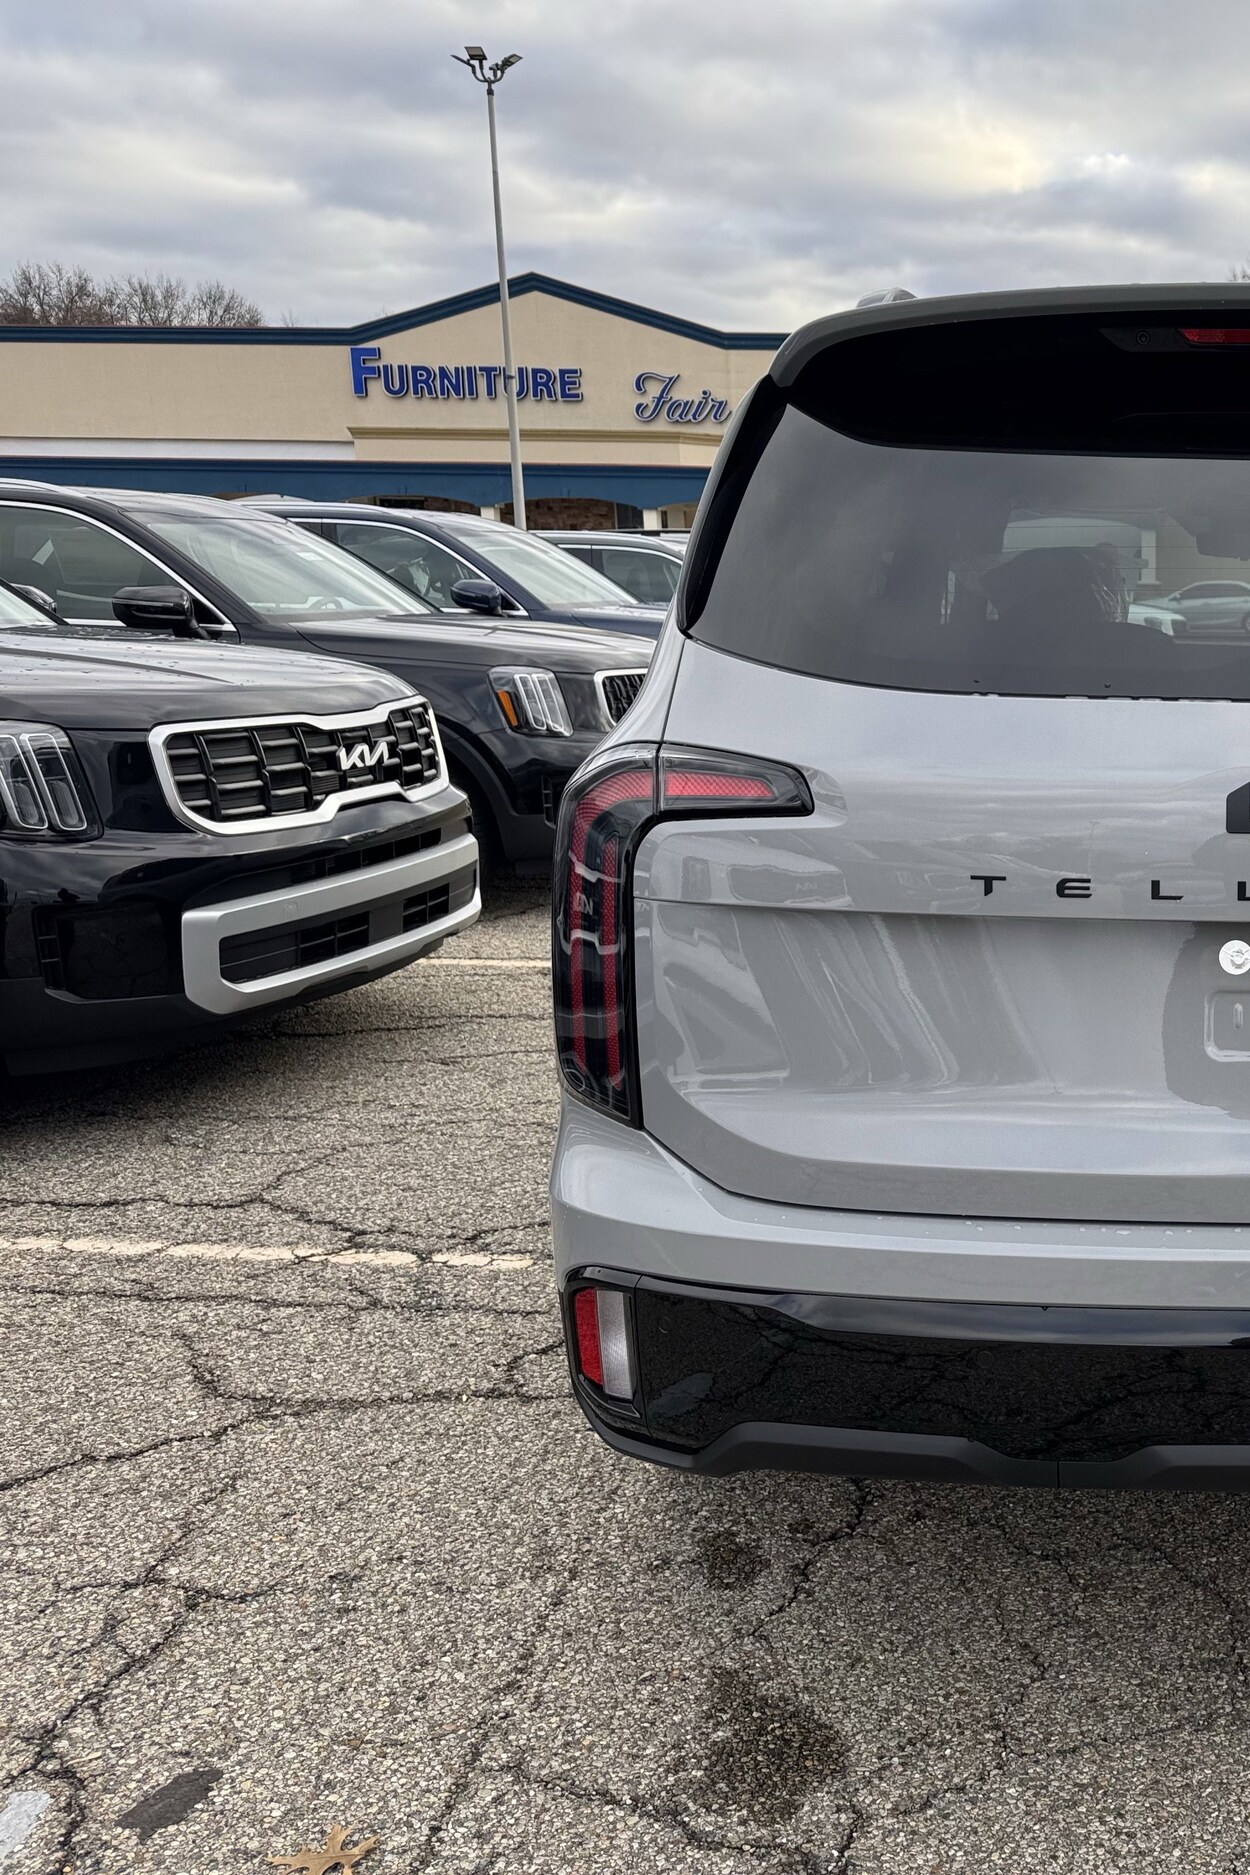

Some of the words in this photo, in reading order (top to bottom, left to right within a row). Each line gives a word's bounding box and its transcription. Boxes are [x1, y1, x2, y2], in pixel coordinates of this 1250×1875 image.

[350, 347, 583, 401] FURNITURE
[634, 371, 732, 423] Fair
[336, 741, 389, 771] KIA
